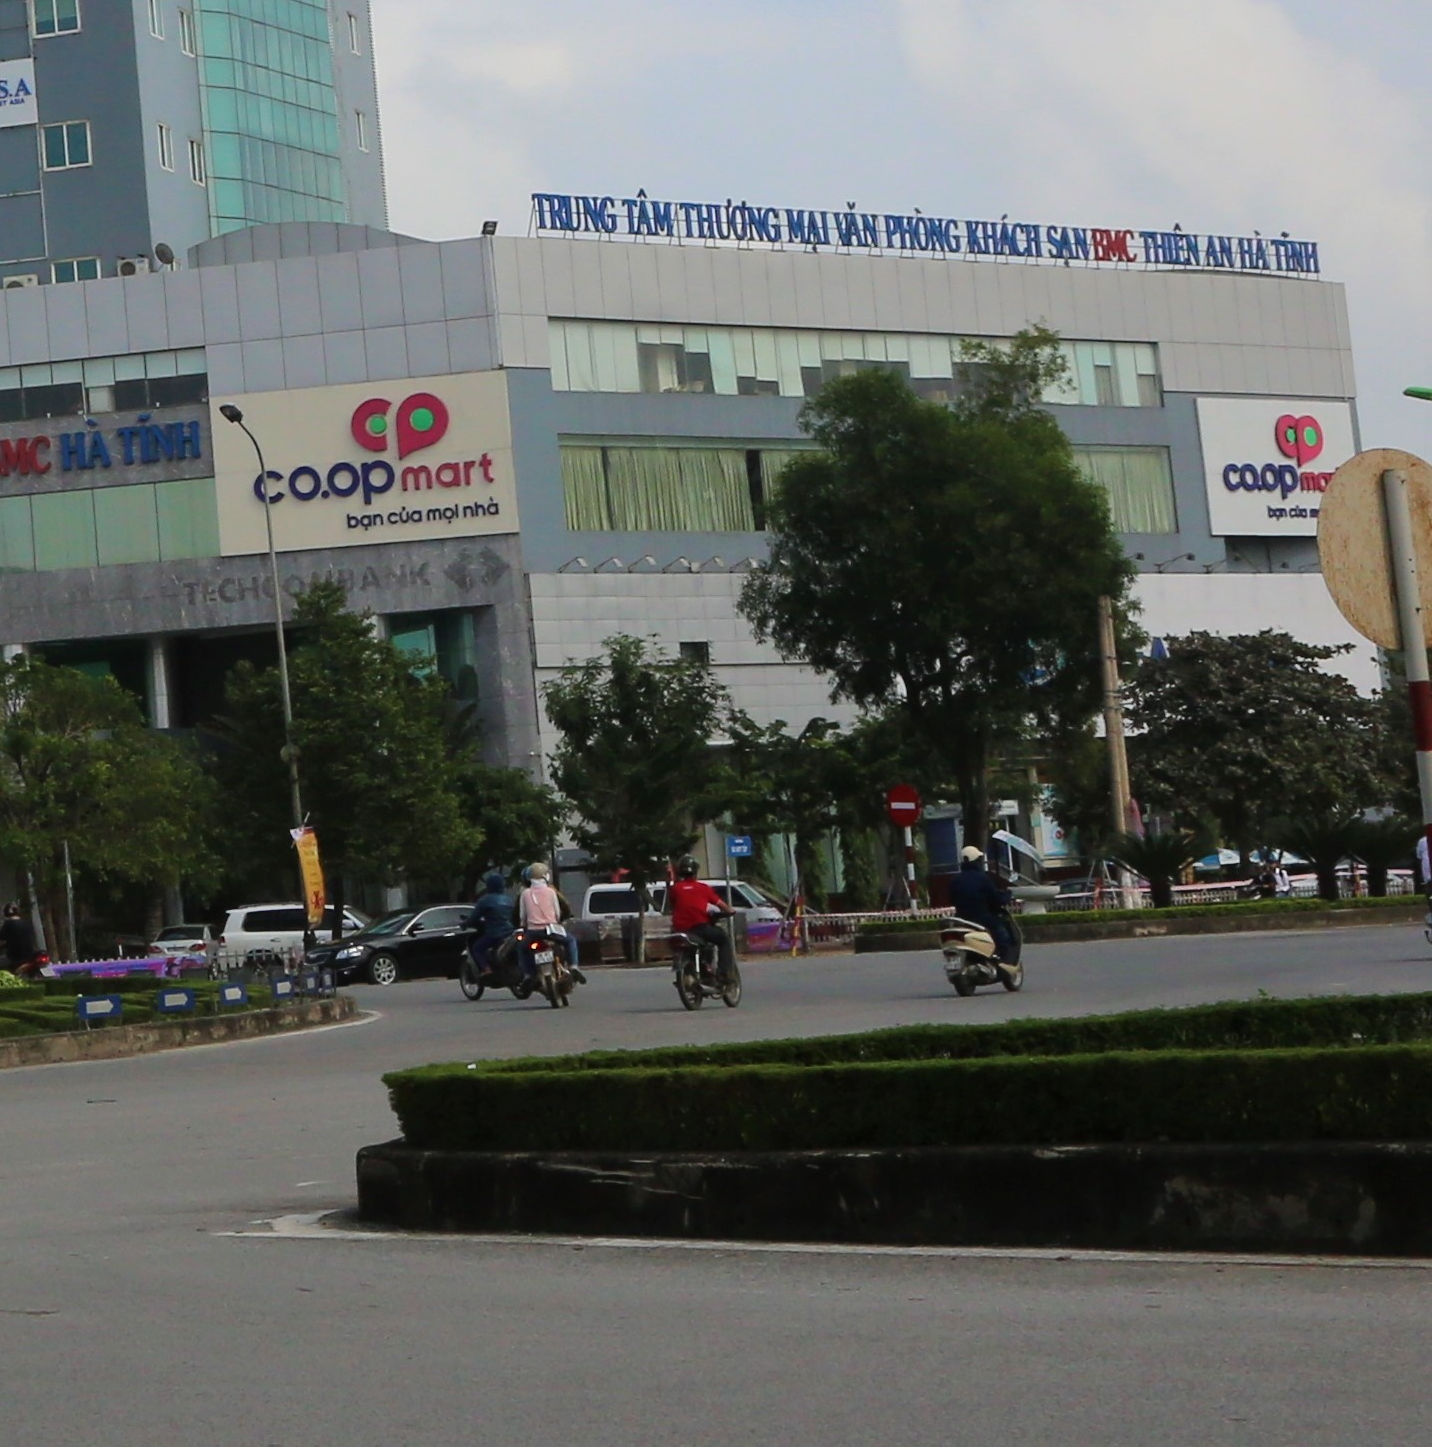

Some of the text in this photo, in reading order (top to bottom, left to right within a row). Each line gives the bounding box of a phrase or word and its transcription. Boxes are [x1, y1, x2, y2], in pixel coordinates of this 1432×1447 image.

[531, 193, 618, 234] TRUNG
[621, 188, 677, 237] TÂM
[678, 198, 781, 243] THƯƠNG
[834, 201, 878, 247] VĂN
[885, 207, 962, 252] PHÒNG
[965, 213, 1044, 257] KHÁCH
[1090, 228, 1138, 263] BMC
[1139, 222, 1201, 266] THIÊN
[1205, 234, 1236, 268] AN
[1237, 229, 1271, 270] HÀ
[60, 417, 113, 471] HÀ
[346, 513, 384, 531] bạn
[387, 507, 423, 524] của
[462, 496, 500, 519] nhà
